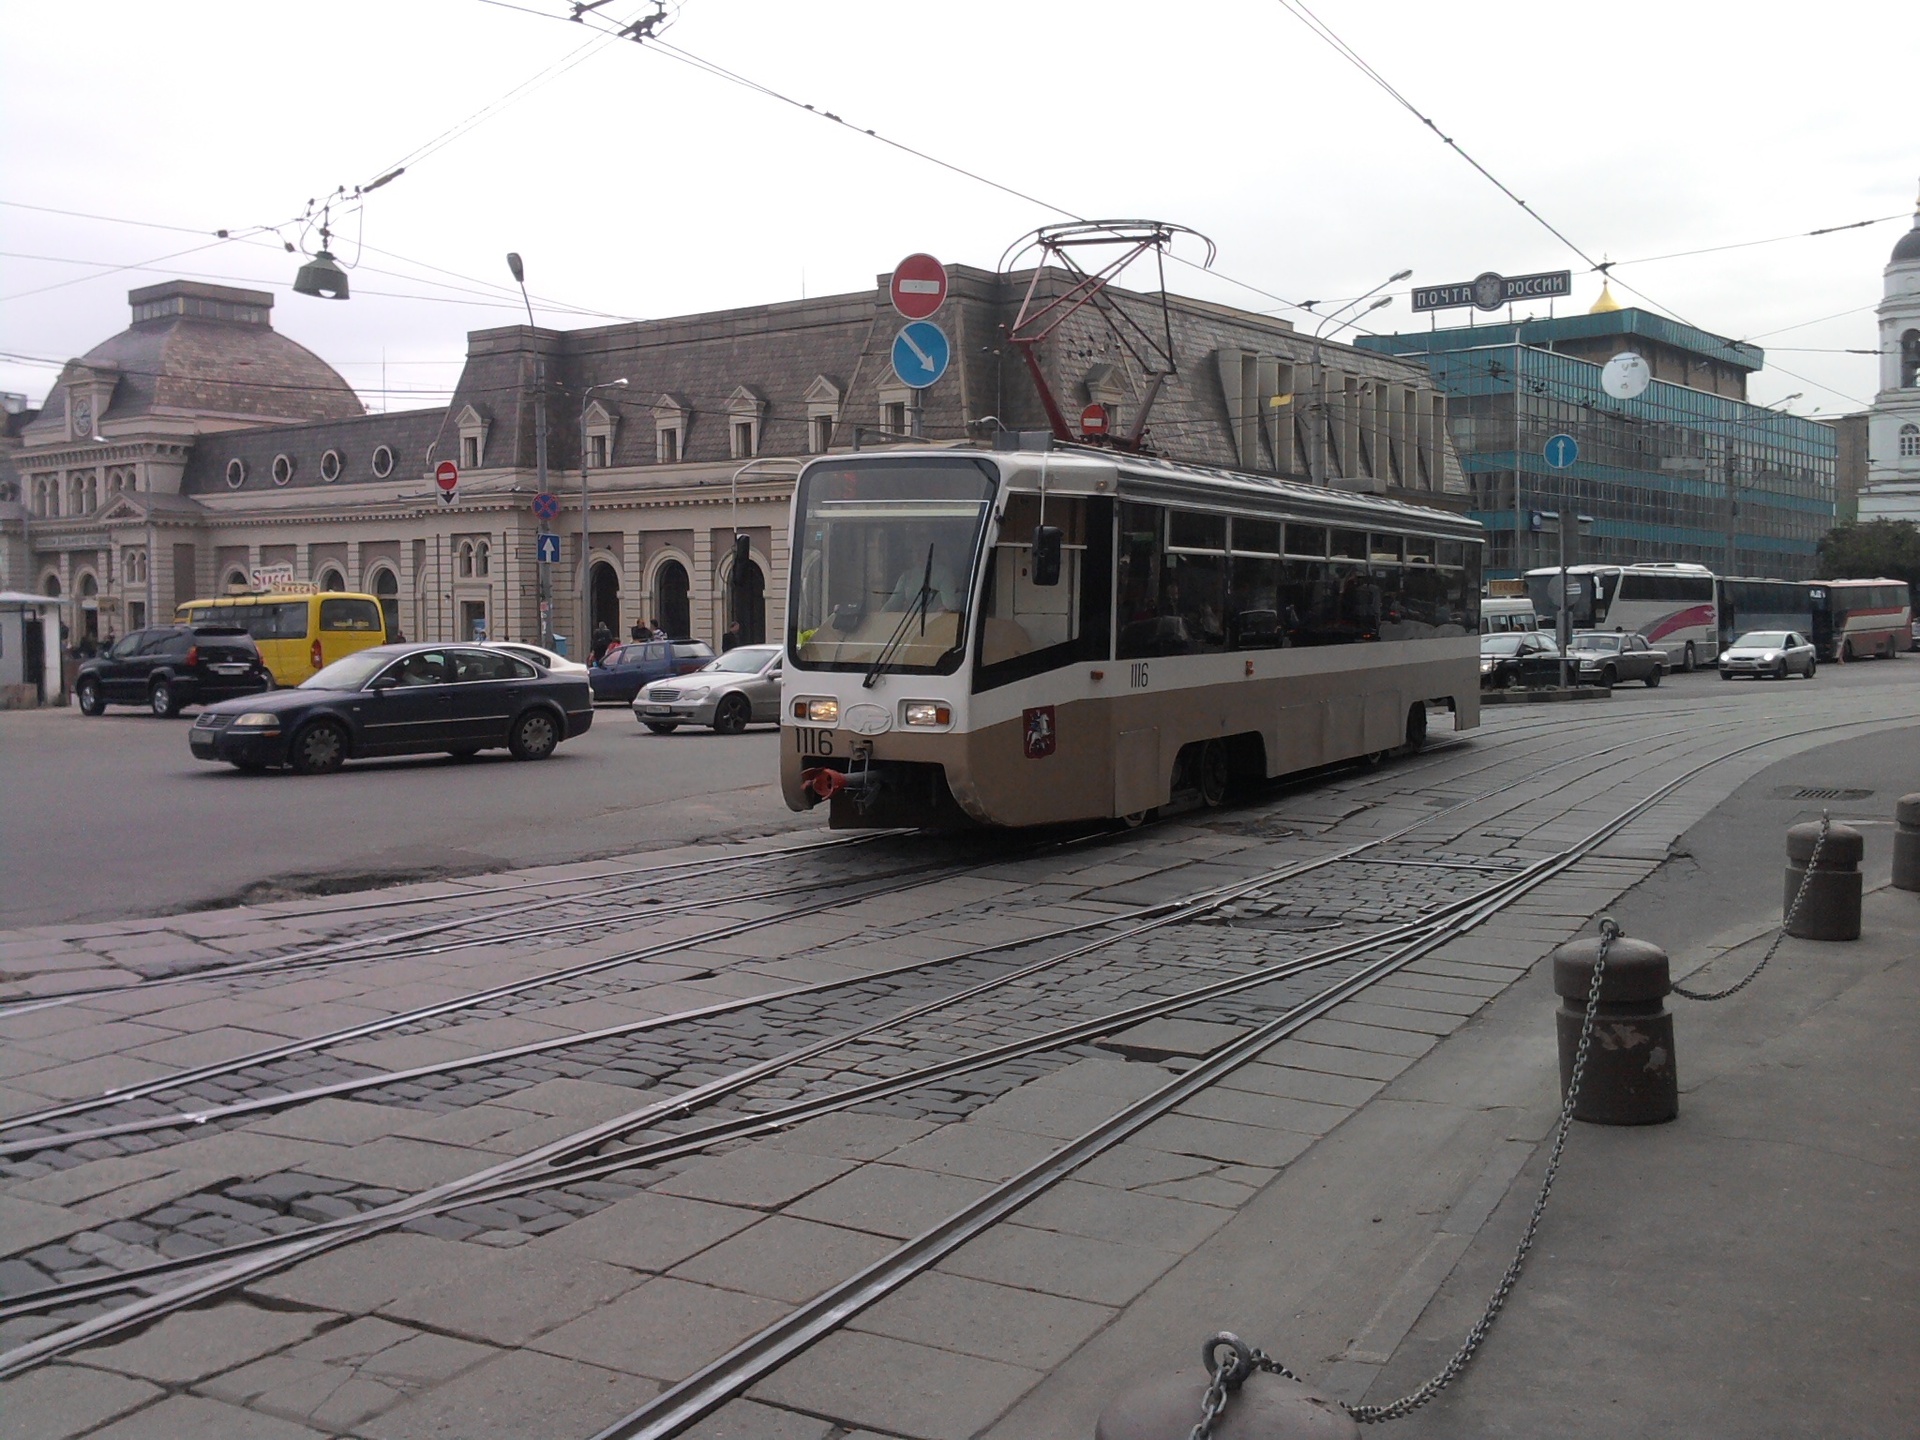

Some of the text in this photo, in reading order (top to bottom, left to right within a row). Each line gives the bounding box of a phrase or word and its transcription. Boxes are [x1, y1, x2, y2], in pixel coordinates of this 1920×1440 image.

[1417, 276, 1563, 307] ПОЧТА РОССИИ
[1131, 662, 1149, 688] 1116
[796, 728, 834, 756] 1116
